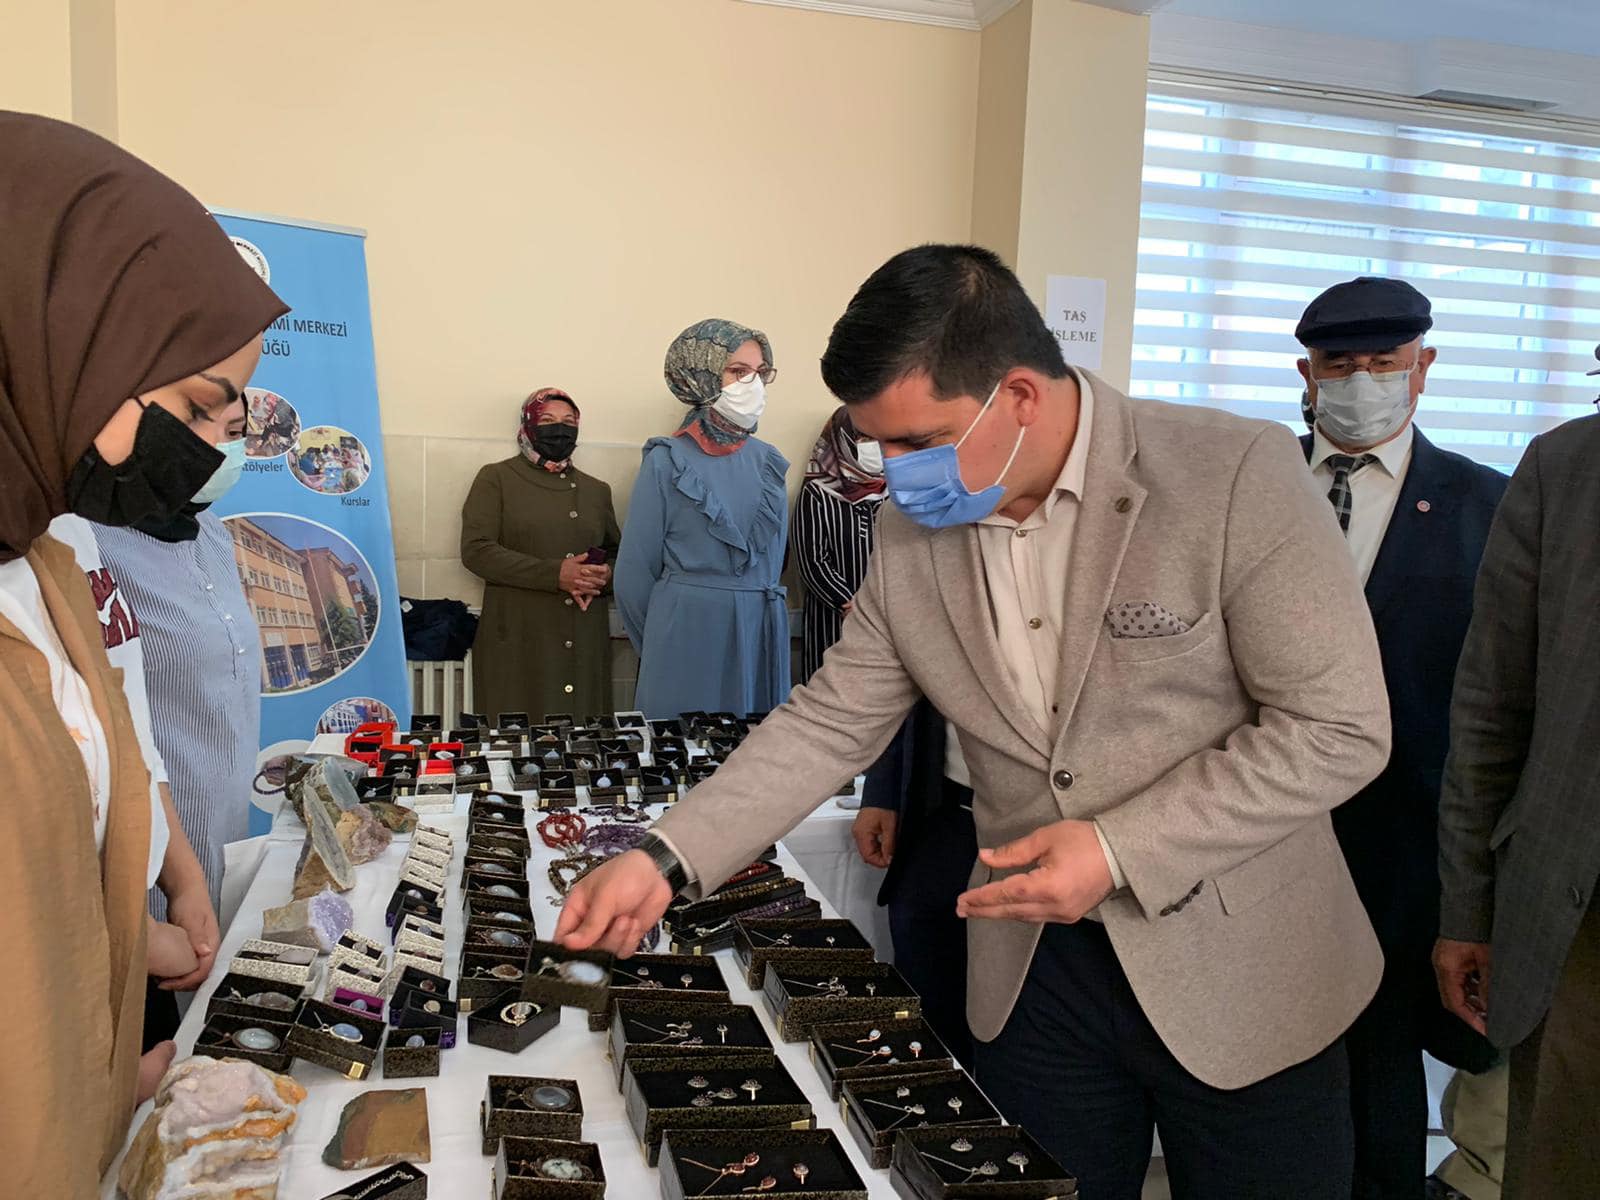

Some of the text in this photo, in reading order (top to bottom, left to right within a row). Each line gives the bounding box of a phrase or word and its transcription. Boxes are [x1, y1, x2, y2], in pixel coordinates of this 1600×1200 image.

[1063, 309, 1087, 323] TAŞ
[293, 319, 348, 337] MERKEZİ
[340, 496, 370, 506] Kurslar
